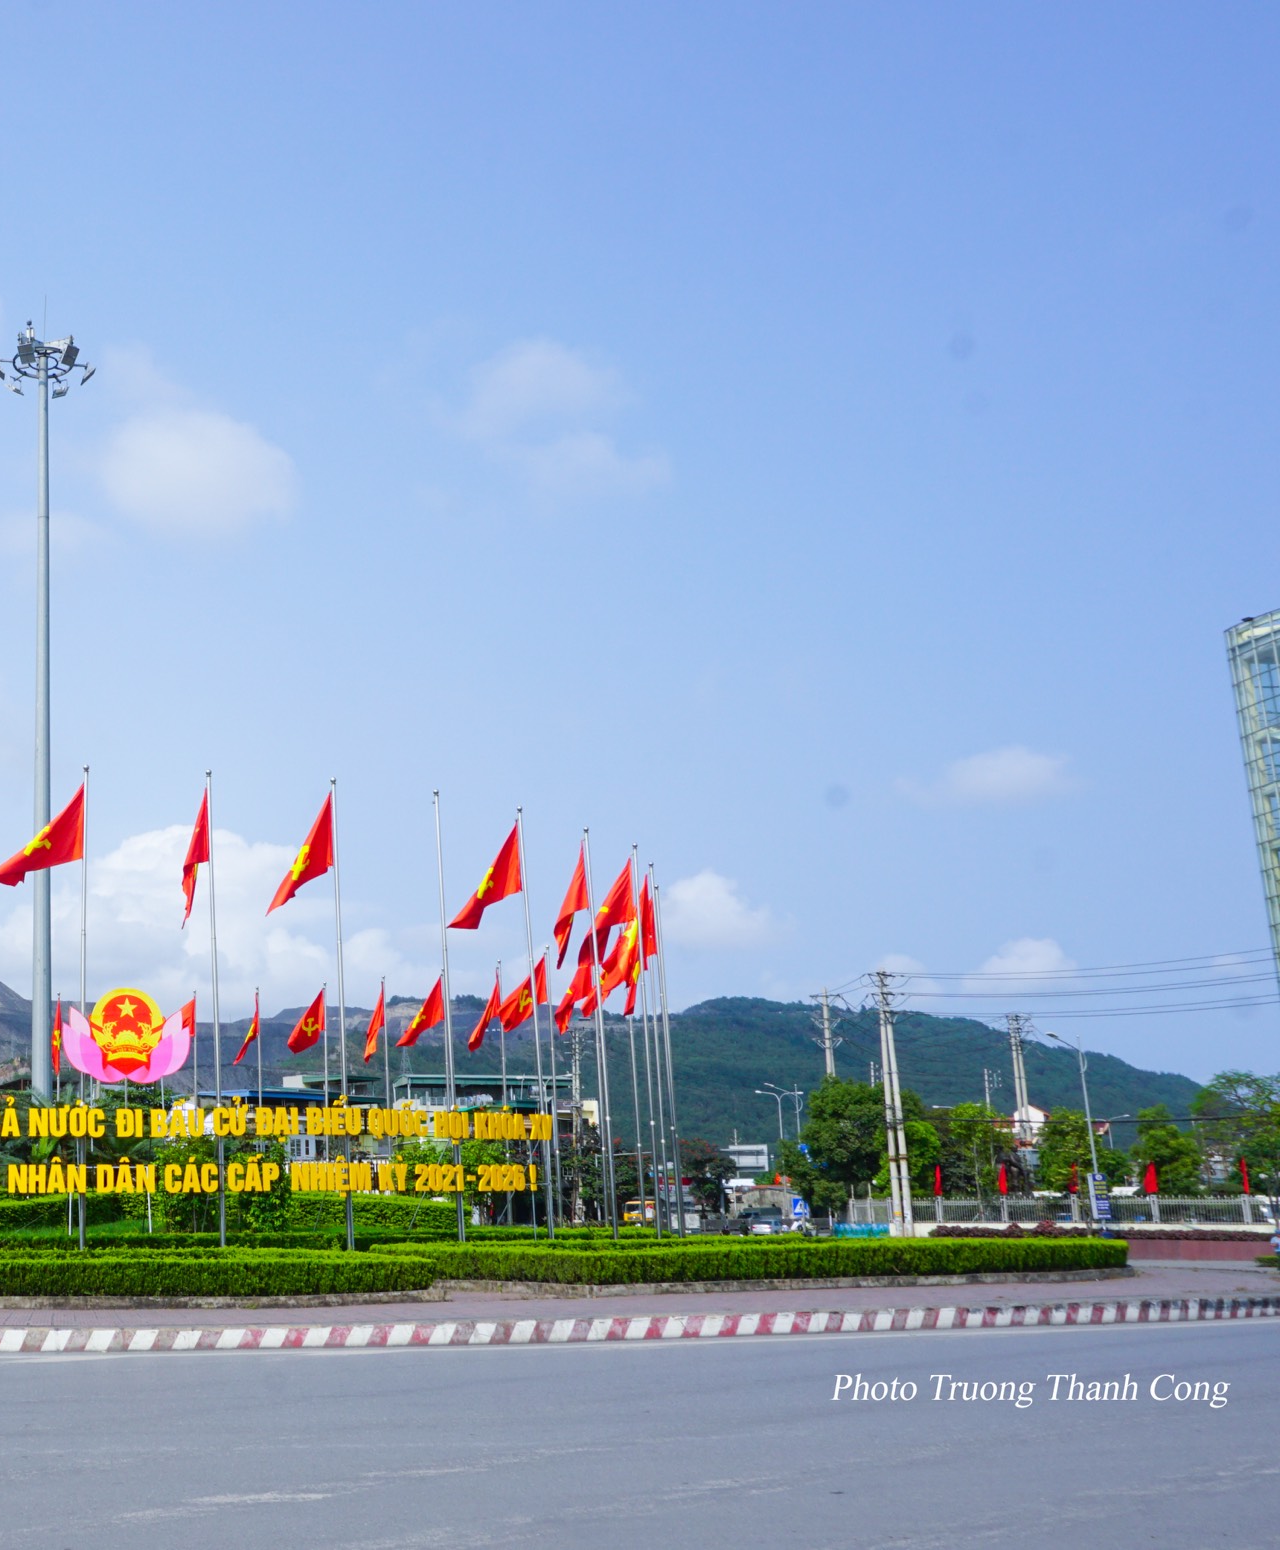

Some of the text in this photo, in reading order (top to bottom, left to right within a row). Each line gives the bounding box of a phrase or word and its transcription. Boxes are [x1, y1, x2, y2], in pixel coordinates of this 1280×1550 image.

[28, 1099, 106, 1138] NƯỚC
[116, 1108, 144, 1138] ĐI
[150, 1097, 206, 1138] BẦU
[212, 1095, 250, 1137] CỬ
[255, 1106, 300, 1143] ĐẠI
[306, 1094, 363, 1137] BIỂU
[368, 1100, 429, 1139] QUỐC
[434, 1104, 470, 1145] HỘI
[528, 1113, 553, 1140] XV
[7, 1157, 87, 1194] NHÂN
[96, 1157, 156, 1194] DÂN
[164, 1157, 219, 1194] CÁC
[227, 1153, 280, 1193] CẤP
[290, 1155, 372, 1198] NHIỆM
[378, 1155, 409, 1192] KỲ
